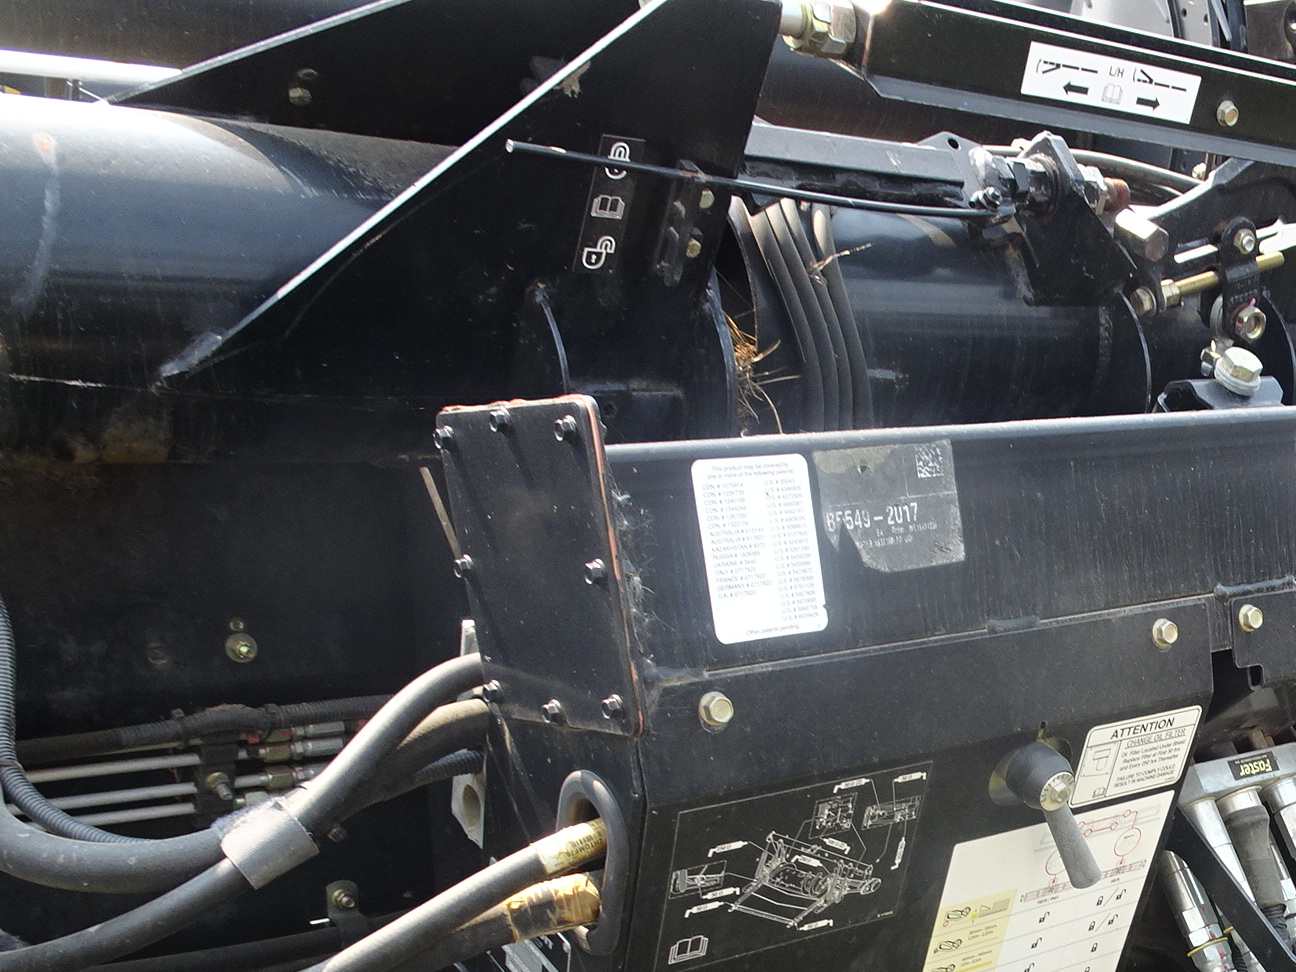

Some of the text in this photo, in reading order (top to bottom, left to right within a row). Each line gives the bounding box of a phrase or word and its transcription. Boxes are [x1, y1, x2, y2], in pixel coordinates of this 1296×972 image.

[1109, 66, 1125, 79] L/H
[1110, 717, 1174, 740] ATTENTION
[1127, 727, 1186, 747] CHANGE OIL FILTER
[1117, 773, 1134, 781] FAILURE
[1159, 764, 1175, 772] COULD
[1240, 758, 1272, 777] Faster
[1113, 779, 1132, 788] RESULT
